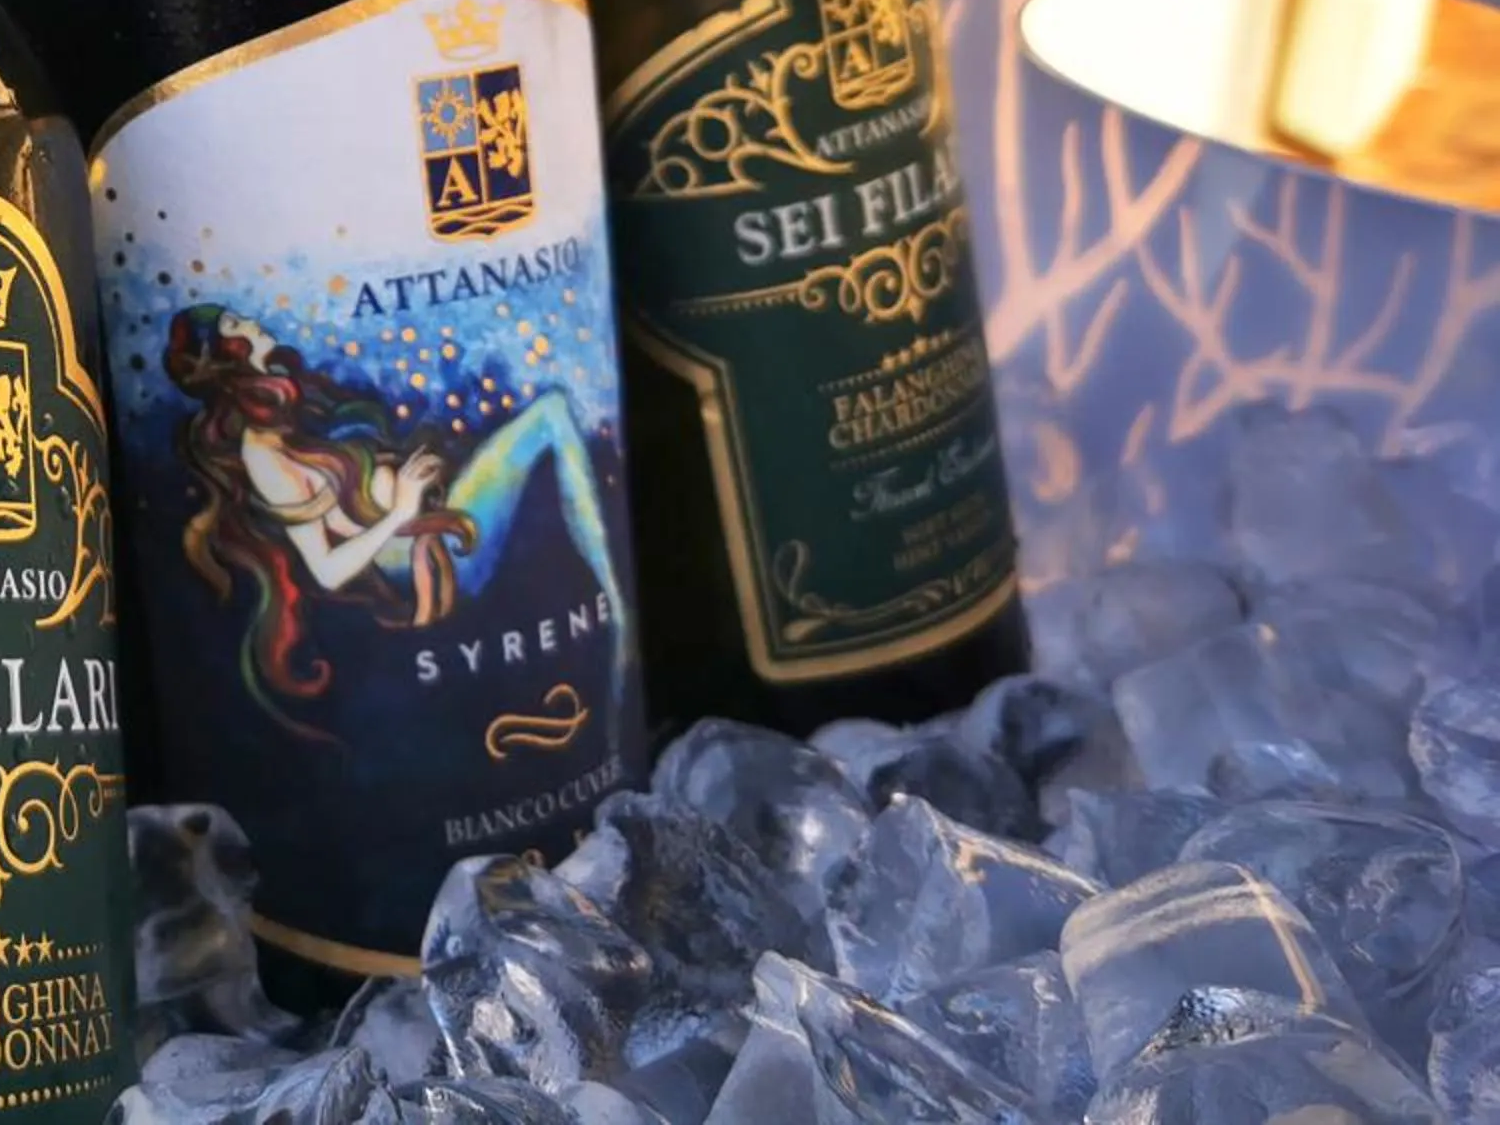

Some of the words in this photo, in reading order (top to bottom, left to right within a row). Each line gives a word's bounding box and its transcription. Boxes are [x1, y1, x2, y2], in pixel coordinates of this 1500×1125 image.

[436, 154, 479, 208] A
[733, 193, 845, 266] SEI
[854, 140, 962, 236] FILA
[350, 235, 581, 319] ATTANASIO
[415, 591, 611, 682] SYRENE
[444, 791, 552, 847] BIANCO
